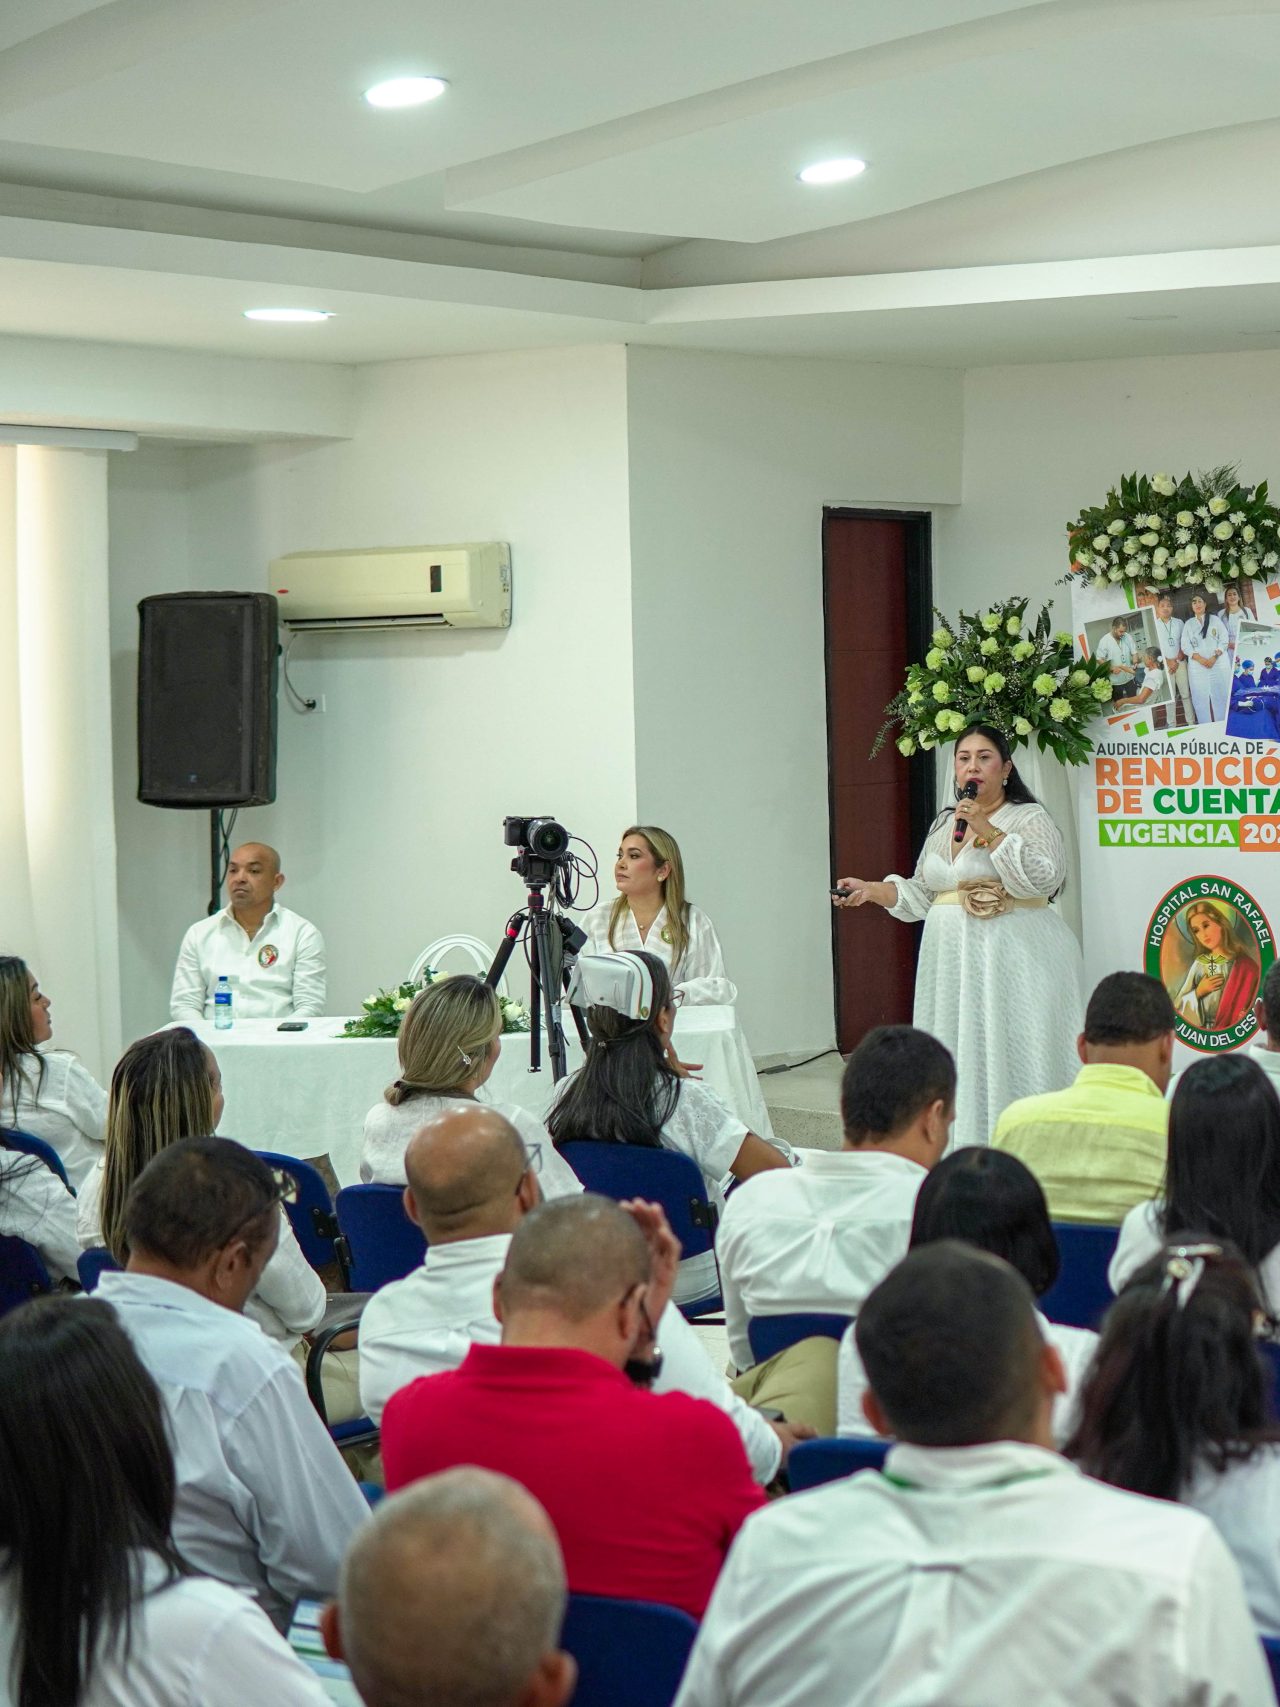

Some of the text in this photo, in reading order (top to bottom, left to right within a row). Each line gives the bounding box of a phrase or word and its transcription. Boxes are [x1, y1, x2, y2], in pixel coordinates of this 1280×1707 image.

[1096, 739, 1263, 756] AUDIENCIA PÚBLICA DE
[1097, 788, 1143, 814] DE
[1104, 823, 1236, 844] VIGENCIA
[1150, 882, 1271, 949] HOSPITAL SAN RAFAEL
[1175, 1023, 1207, 1046] JUAN
[1210, 1033, 1236, 1047] DEL
